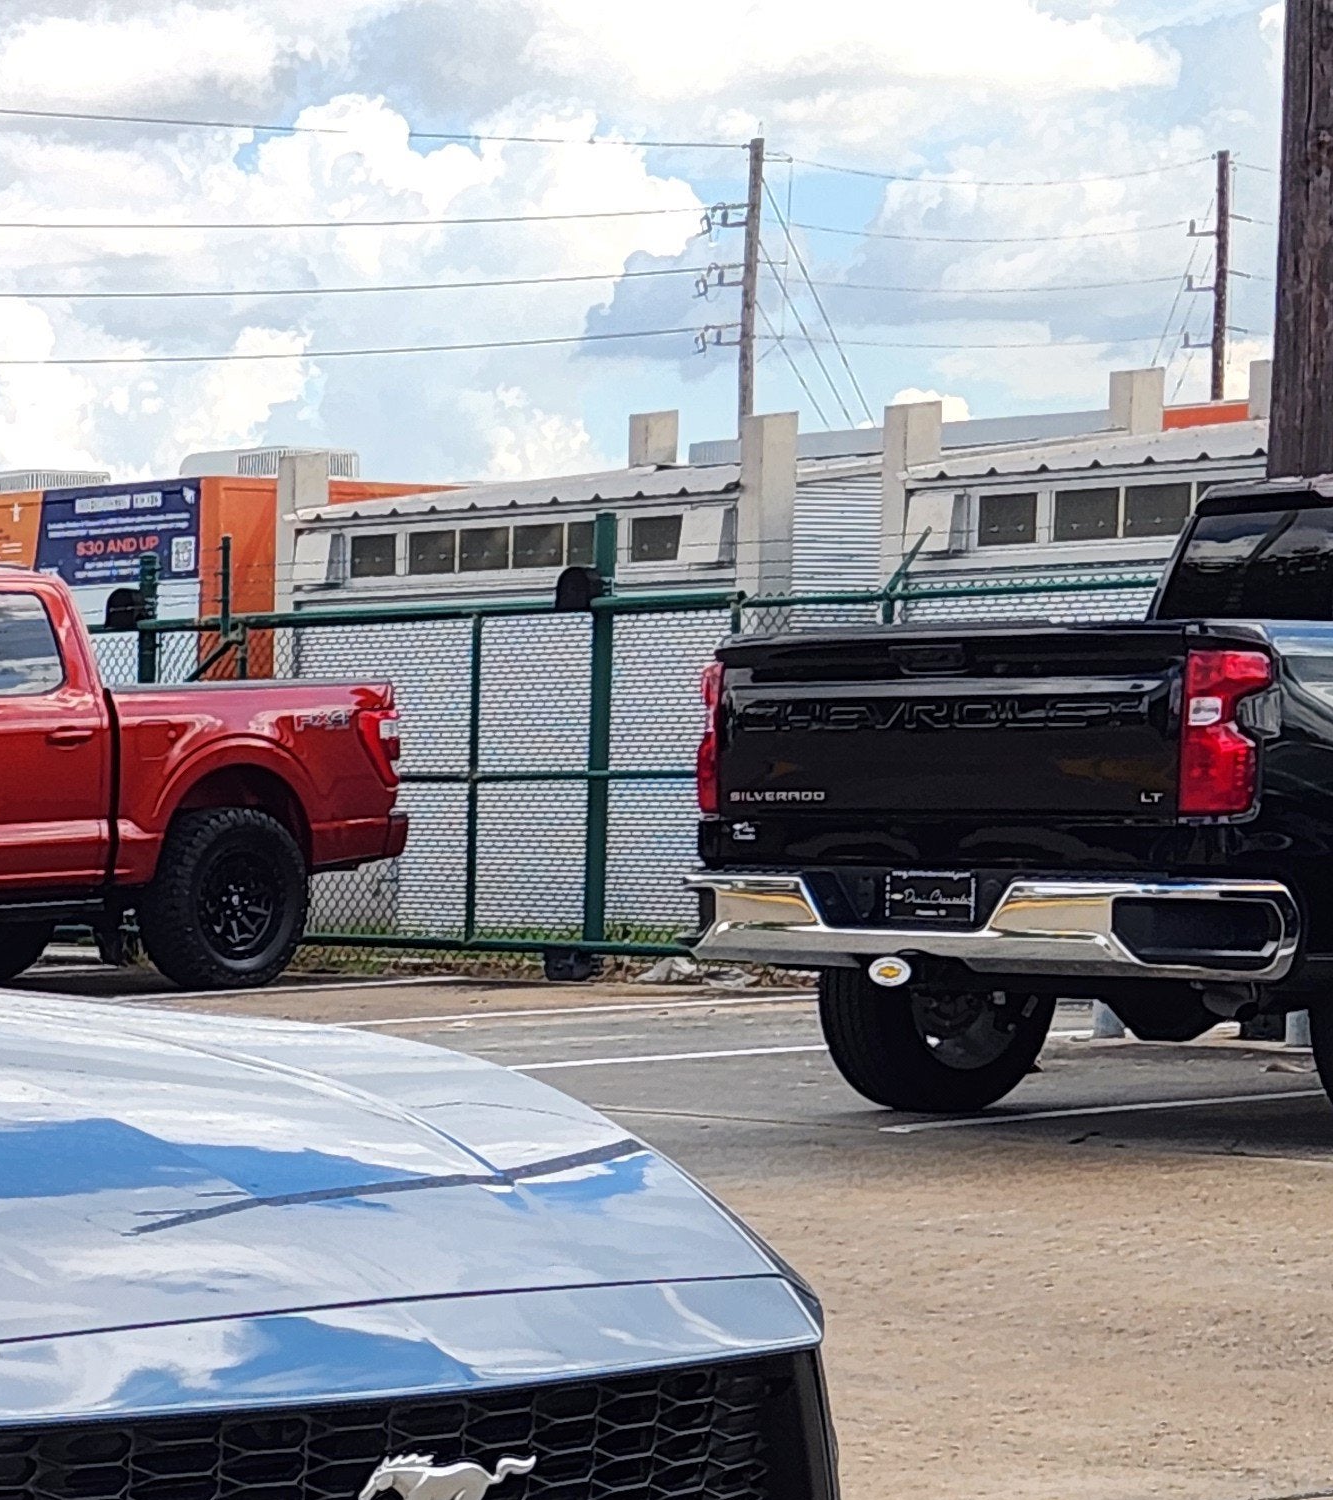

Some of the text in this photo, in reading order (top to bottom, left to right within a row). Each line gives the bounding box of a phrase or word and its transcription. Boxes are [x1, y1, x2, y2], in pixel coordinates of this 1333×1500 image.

[76, 535, 160, 557] $30 AND UP
[294, 709, 350, 731] FX4
[739, 697, 1151, 732] CHEVROLET
[730, 791, 826, 802] SILVERADO
[1140, 791, 1164, 803] LT
